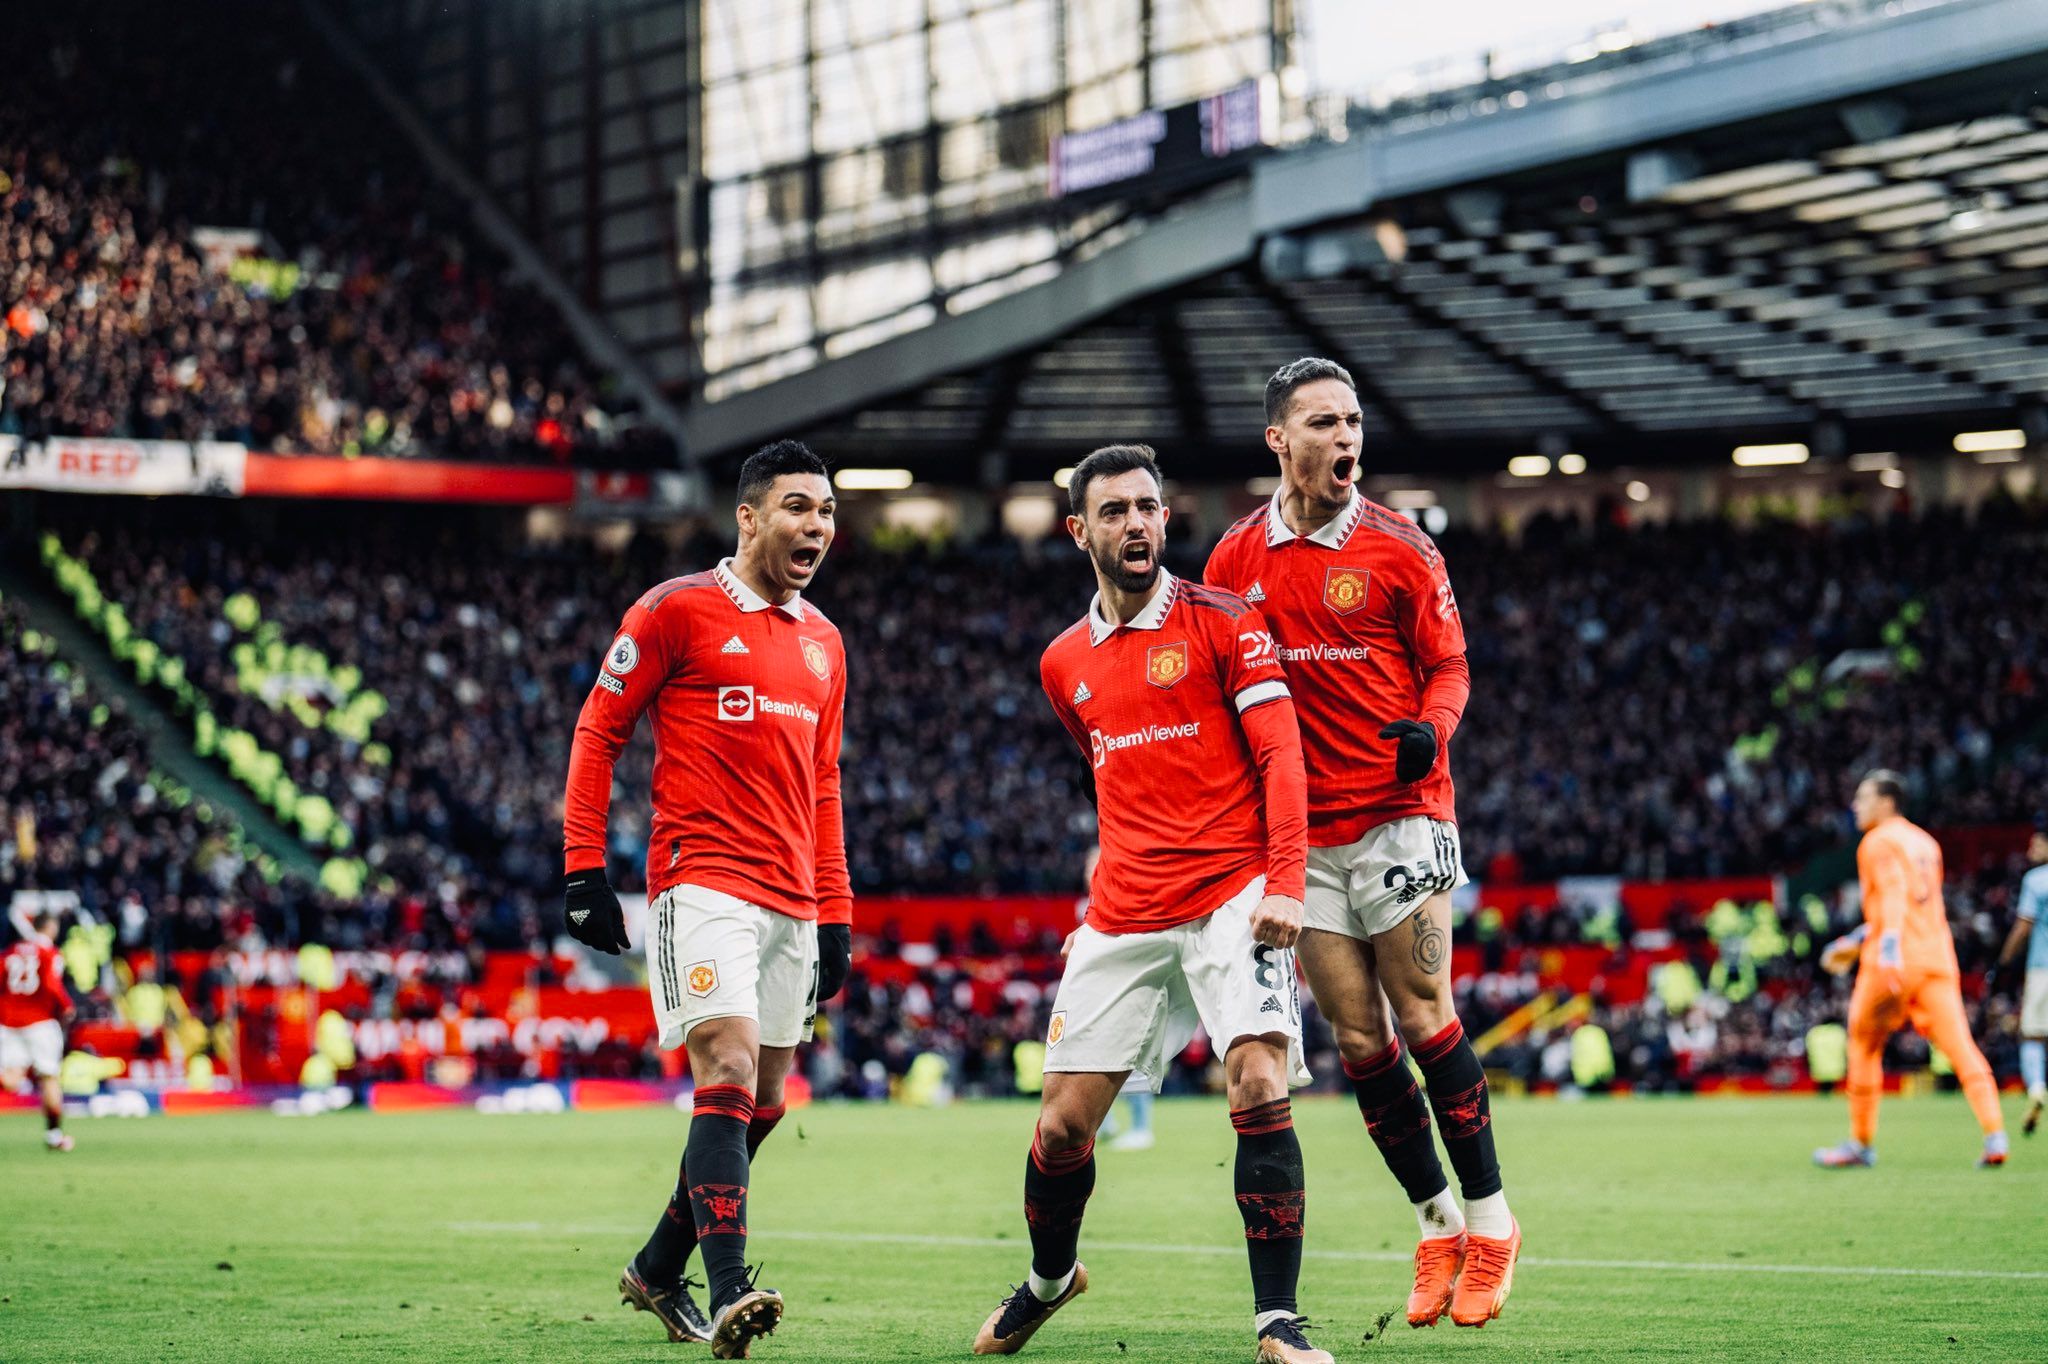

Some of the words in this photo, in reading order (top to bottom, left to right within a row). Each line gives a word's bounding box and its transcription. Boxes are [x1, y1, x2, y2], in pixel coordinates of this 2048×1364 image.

[1274, 643, 1370, 662] TeamViewer
[756, 695, 819, 726] TeamView
[1103, 722, 1200, 752] TeamViewer
[1253, 942, 1284, 991] 8
